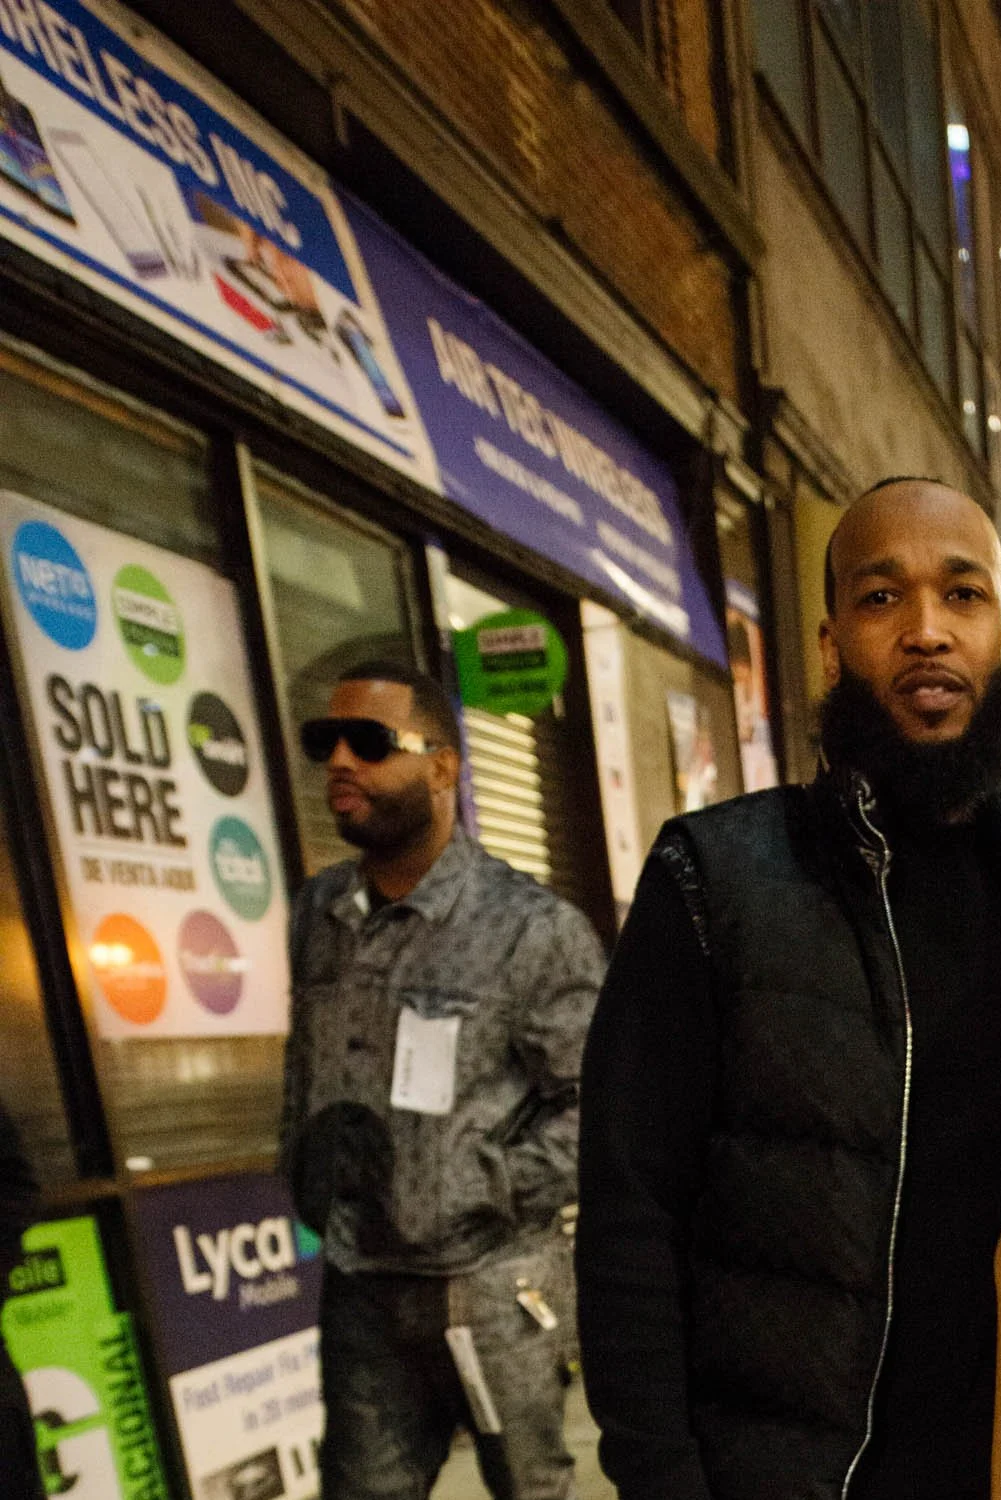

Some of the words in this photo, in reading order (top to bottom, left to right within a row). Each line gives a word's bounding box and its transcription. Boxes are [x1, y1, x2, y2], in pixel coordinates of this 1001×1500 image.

[47, 672, 172, 769] SOLD
[62, 758, 189, 848] HERE
[173, 1216, 297, 1300] Lyca
